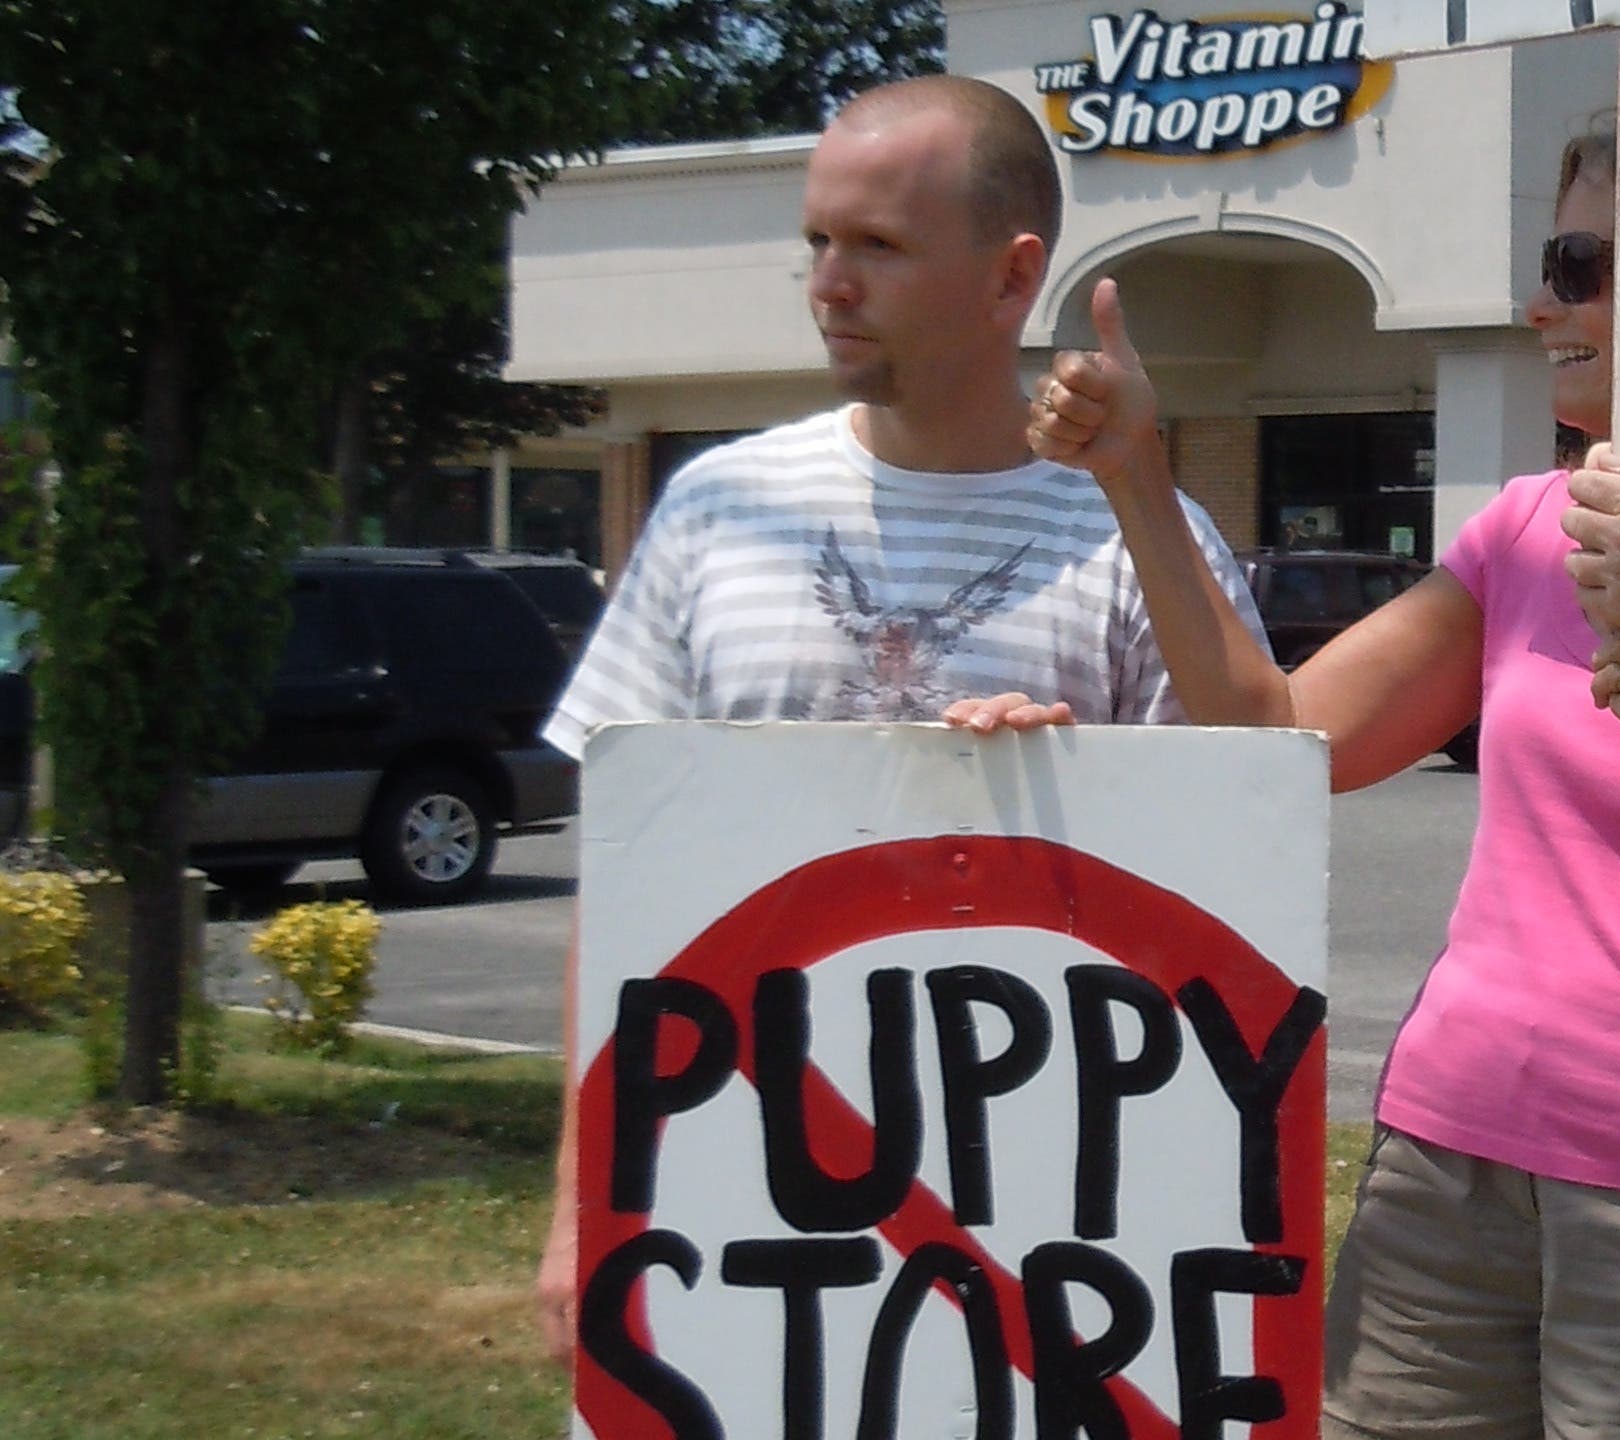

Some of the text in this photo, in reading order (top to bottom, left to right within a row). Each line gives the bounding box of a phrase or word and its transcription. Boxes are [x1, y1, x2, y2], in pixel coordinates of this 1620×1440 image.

[1035, 63, 1089, 93] THE
[1090, 0, 1366, 85] Vitamin
[1061, 81, 1342, 154] Shoppe
[609, 962, 1328, 1243] PUPPY
